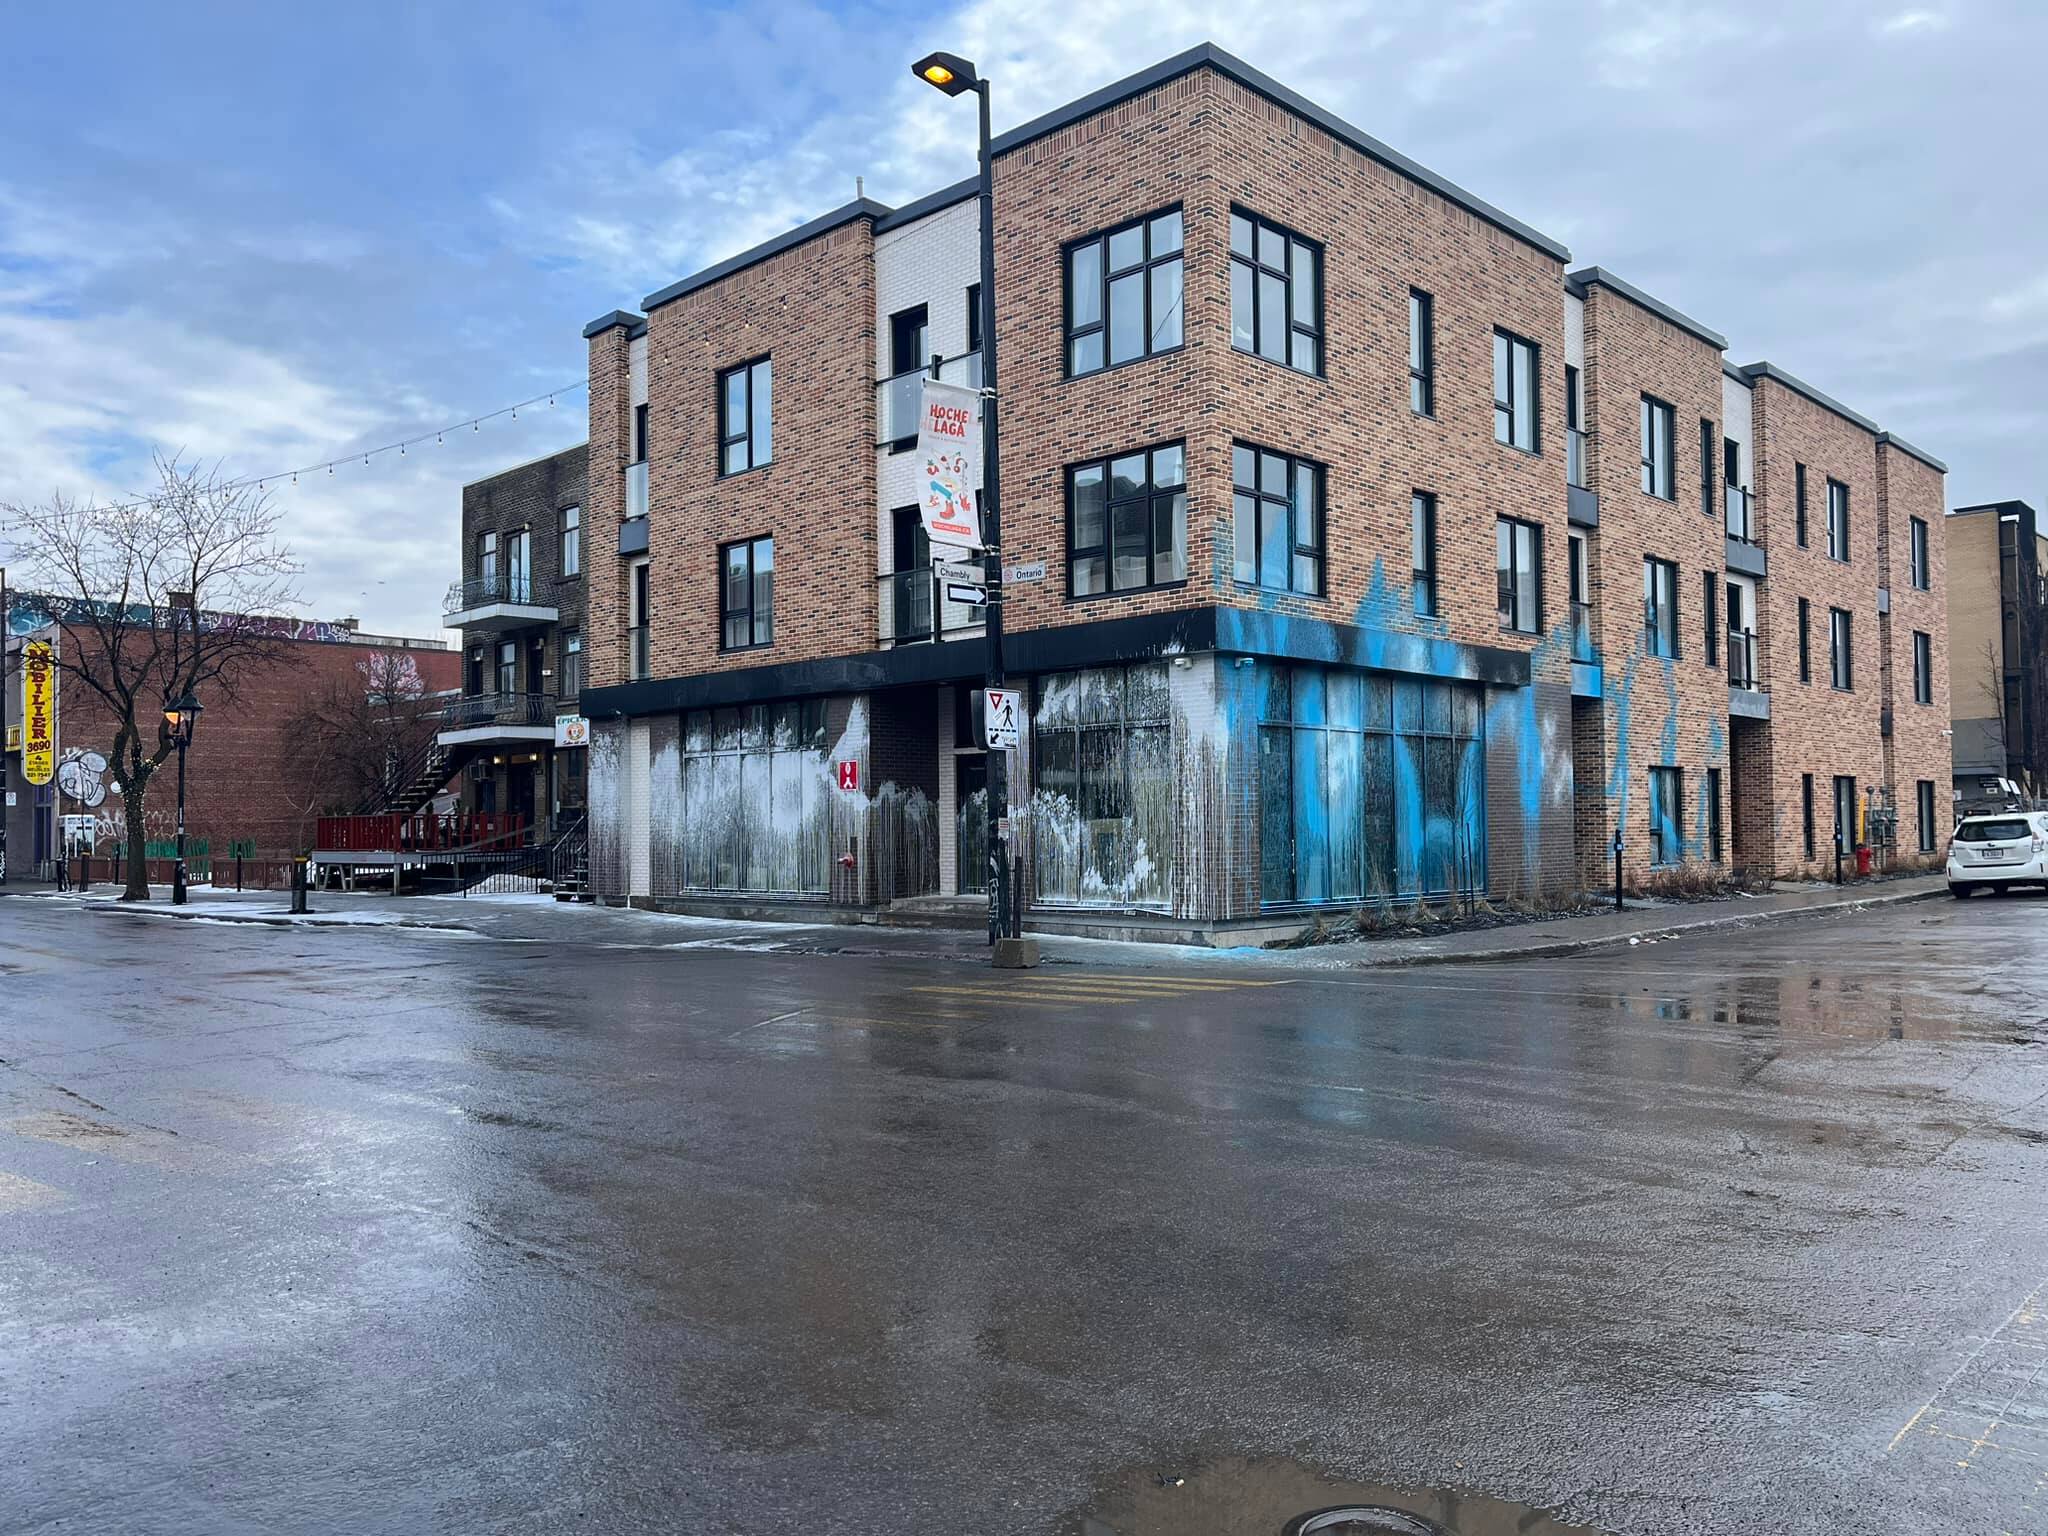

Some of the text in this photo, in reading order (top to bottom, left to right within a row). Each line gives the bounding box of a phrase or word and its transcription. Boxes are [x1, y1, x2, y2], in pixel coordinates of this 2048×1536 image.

[929, 404, 969, 424] HOCHE
[933, 419, 965, 438] LAGA
[940, 567, 970, 581] Chambly
[1016, 567, 1042, 580] Ontario
[28, 649, 49, 739] MOBILIER
[27, 740, 51, 753] 3690
